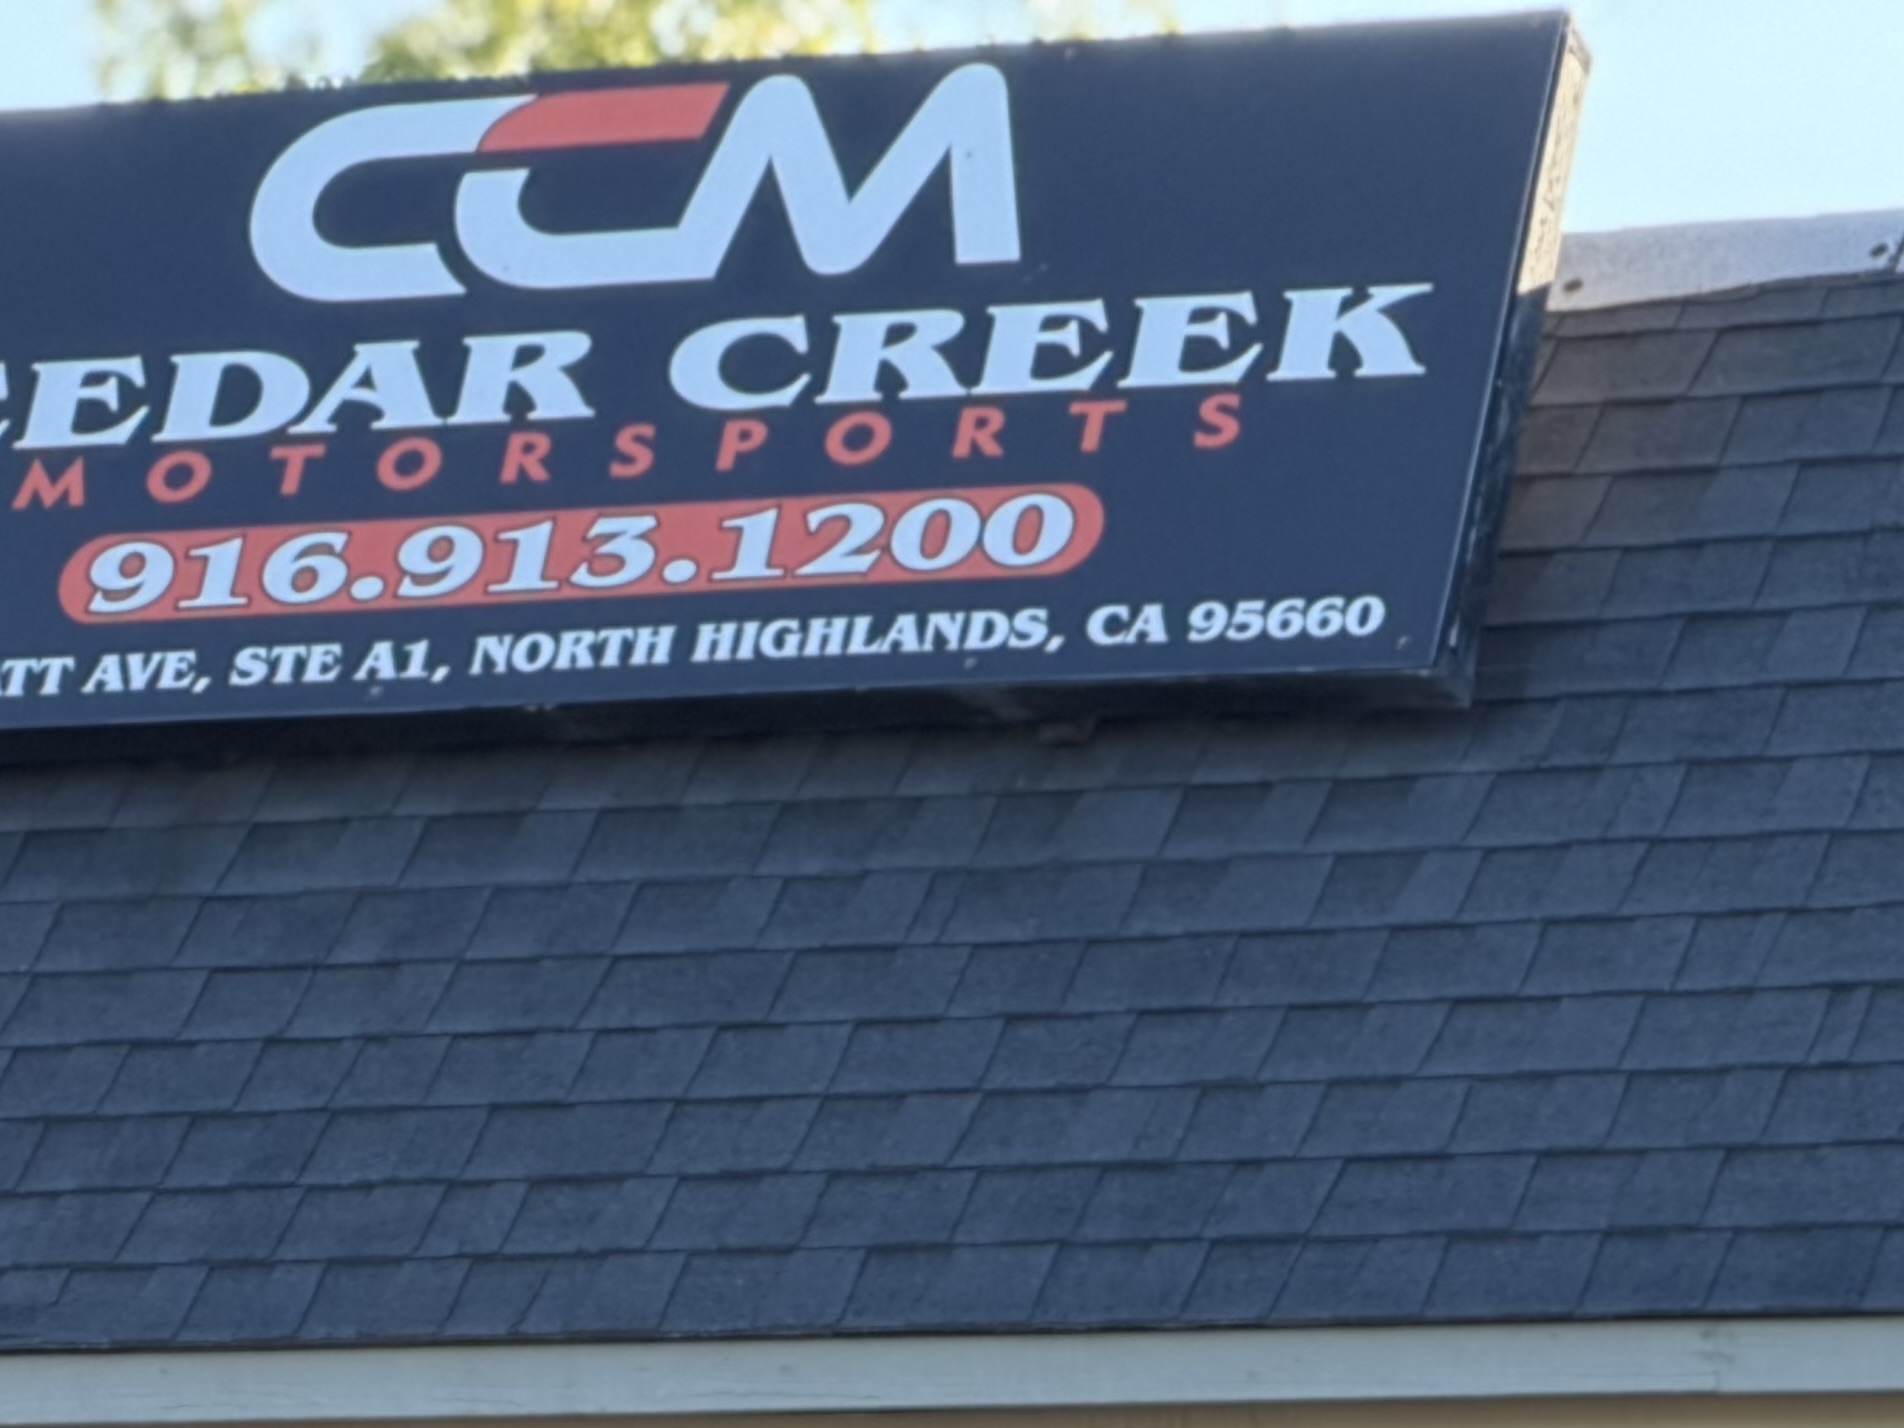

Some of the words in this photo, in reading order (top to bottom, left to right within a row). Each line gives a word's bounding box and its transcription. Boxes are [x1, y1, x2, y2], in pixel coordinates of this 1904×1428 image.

[249, 62, 1021, 303] CCM
[668, 281, 1435, 410] CREEK
[12, 392, 1246, 511] MOTORSPORTS
[86, 490, 1077, 614] 916.913.1200
[81, 649, 211, 695] AVE,
[228, 642, 342, 686] STE
[354, 638, 450, 683] A1,
[469, 624, 674, 676] NORTH
[690, 608, 1064, 663] HIGHLANDS,
[1086, 602, 1168, 644] CA
[1187, 596, 1386, 641] 95660
